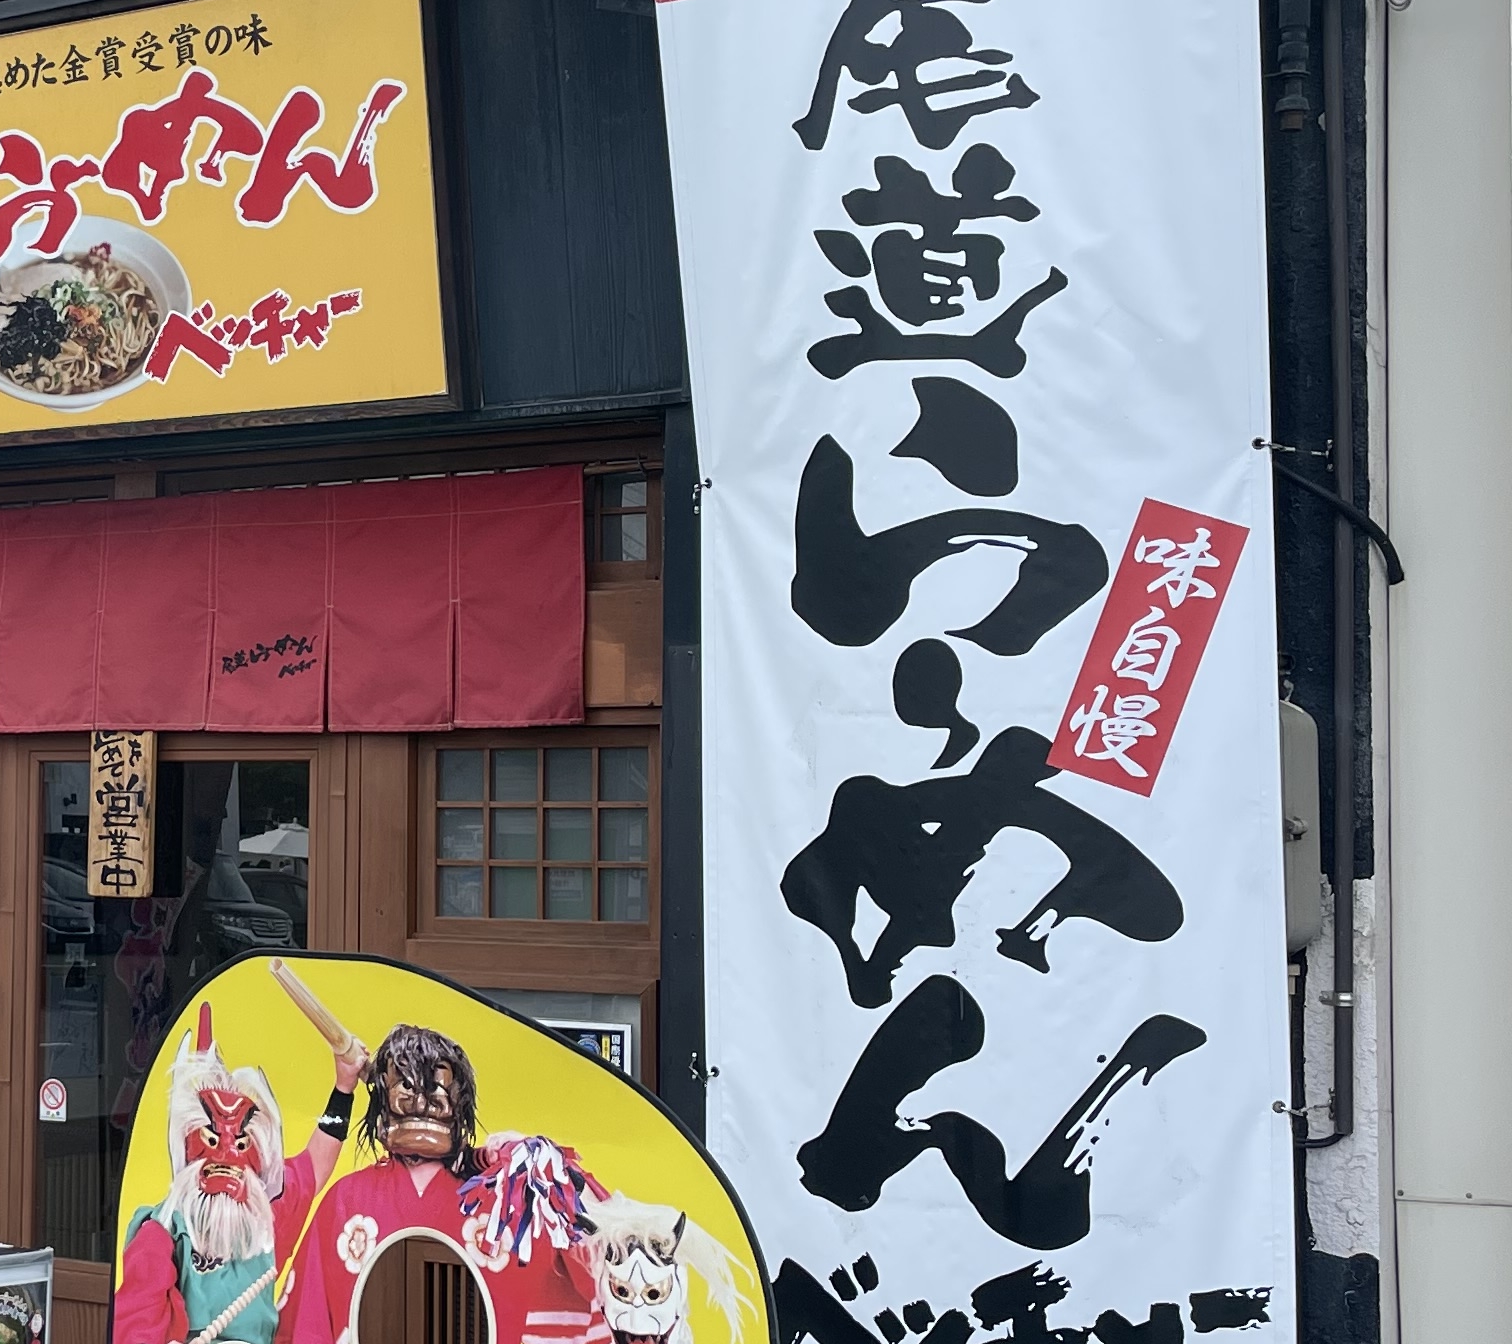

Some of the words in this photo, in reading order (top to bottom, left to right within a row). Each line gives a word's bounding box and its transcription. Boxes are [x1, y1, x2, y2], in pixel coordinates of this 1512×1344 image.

[142, 288, 363, 384] ベッチャー
[1068, 525, 1223, 778] 味自慢
[92, 773, 144, 895] 営業中
